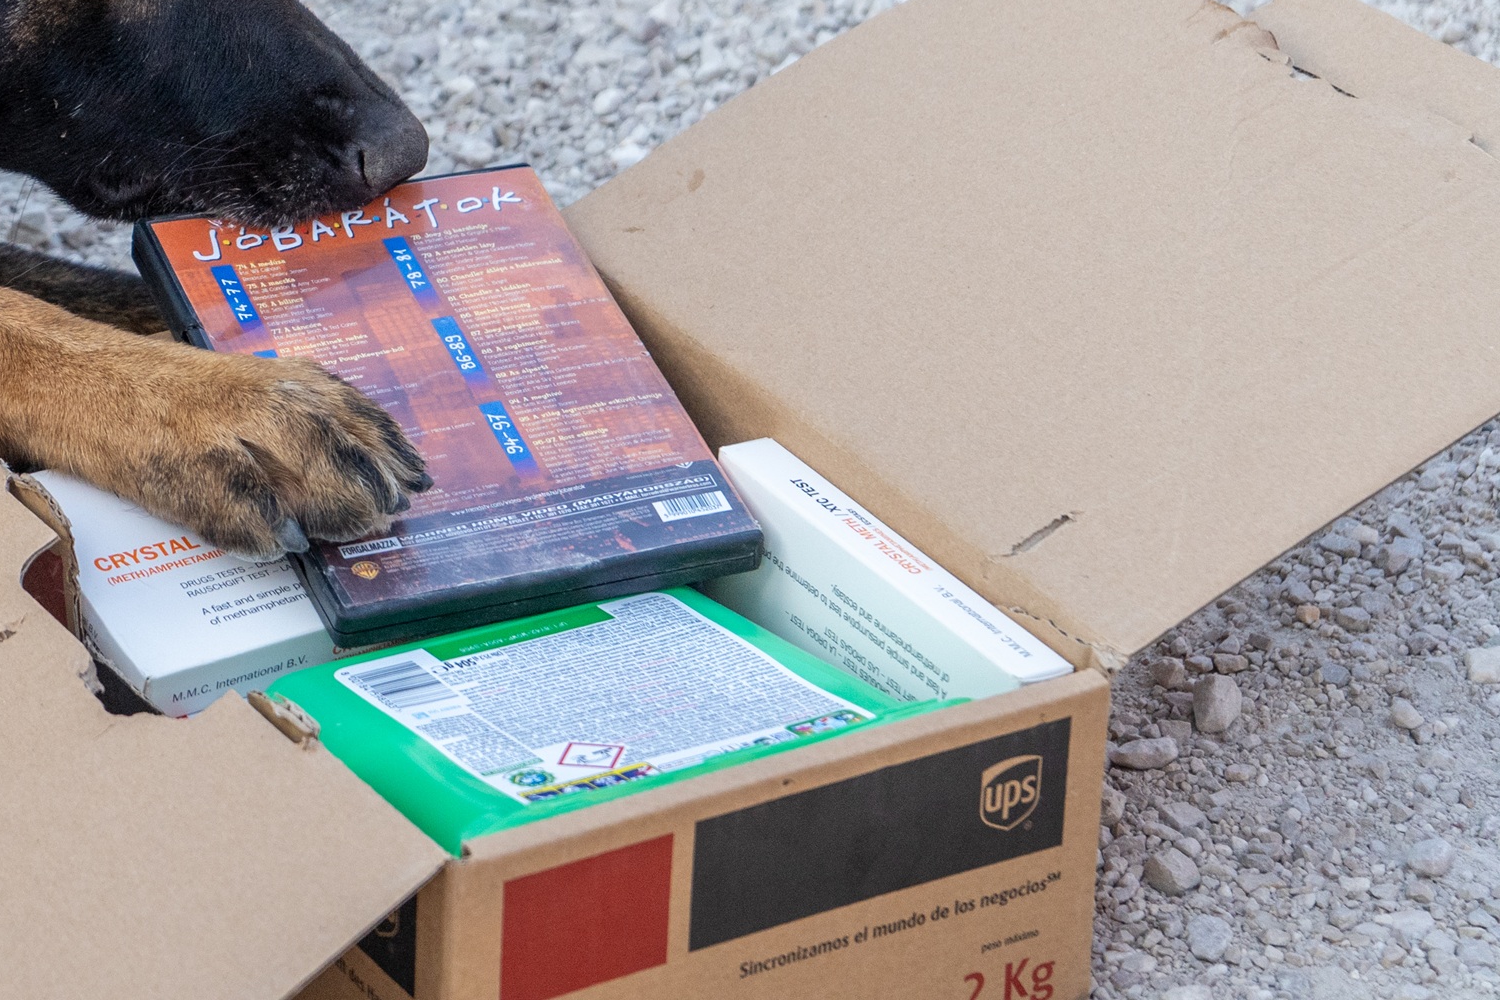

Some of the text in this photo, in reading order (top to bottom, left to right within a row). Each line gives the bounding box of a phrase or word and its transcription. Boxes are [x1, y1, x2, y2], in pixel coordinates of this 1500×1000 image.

[790, 478, 819, 498] TEST
[519, 503, 568, 517] VIDEO
[817, 498, 837, 513] XTC
[842, 517, 875, 539] METH
[92, 535, 202, 573] CRYSTAL
[876, 540, 921, 575] CRYSTAL
[179, 573, 216, 590] DRUGS
[215, 566, 247, 583] TESTS
[185, 576, 246, 599] RAUSCHGIFT
[245, 569, 270, 585] TEST
[201, 606, 211, 617] A
[210, 600, 233, 613] fast
[234, 593, 256, 607] and
[256, 583, 291, 601] simple
[209, 613, 222, 626] of
[172, 653, 308, 703] M.M.C. International B.V.
[985, 774, 1037, 820] ups
[739, 933, 850, 979] Sincronizamos
[854, 926, 868, 944] el
[872, 909, 926, 937] mundo
[931, 905, 950, 921] de
[954, 899, 976, 916] los
[980, 938, 1002, 954] peso
[1003, 957, 1056, 1000] Kg
